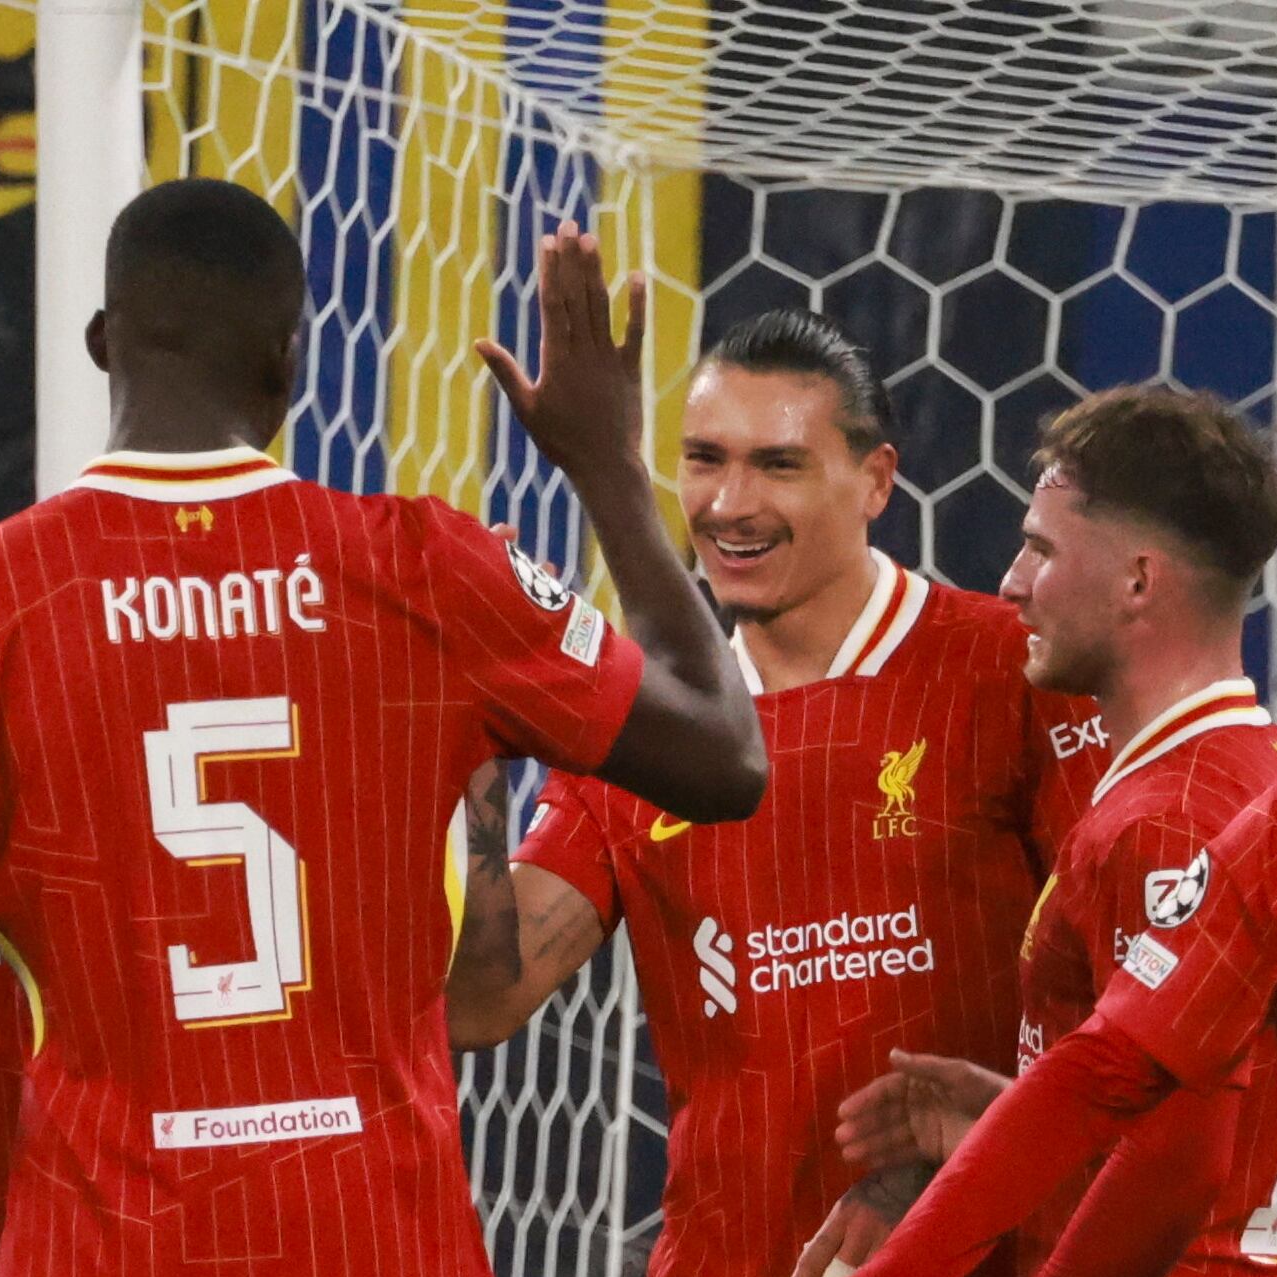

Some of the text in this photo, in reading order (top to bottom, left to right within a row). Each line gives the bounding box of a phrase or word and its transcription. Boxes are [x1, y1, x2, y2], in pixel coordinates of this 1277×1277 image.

[142, 695, 314, 1030] 5
[746, 903, 919, 960] standard
[749, 938, 934, 993] chartered
[193, 1106, 351, 1140] Foundation
